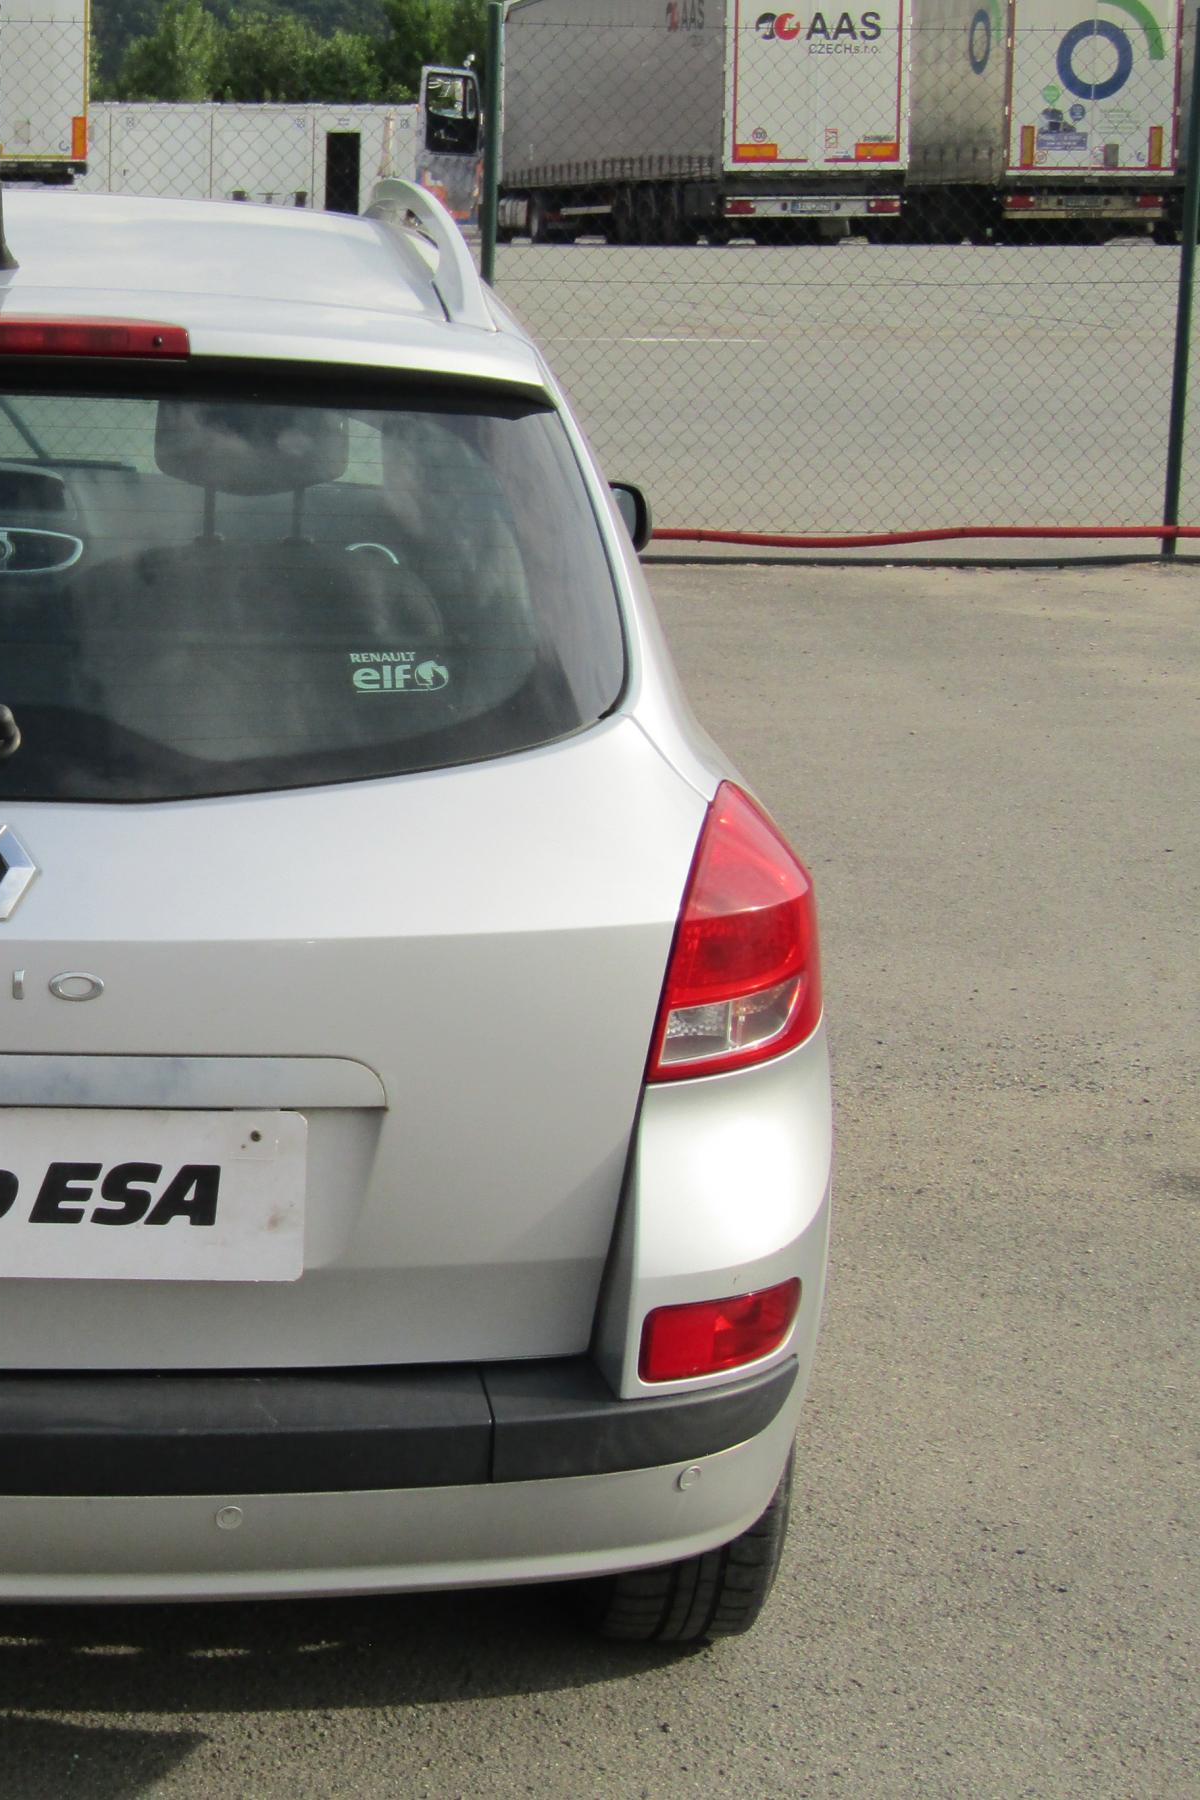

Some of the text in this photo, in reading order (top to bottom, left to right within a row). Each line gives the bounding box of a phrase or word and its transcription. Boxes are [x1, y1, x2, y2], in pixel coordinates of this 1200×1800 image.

[806, 12, 882, 40] AAS
[808, 43, 852, 54] CZECH
[349, 652, 416, 663] RENAULT
[353, 664, 411, 689] elf
[28, 1161, 222, 1227] ESA
